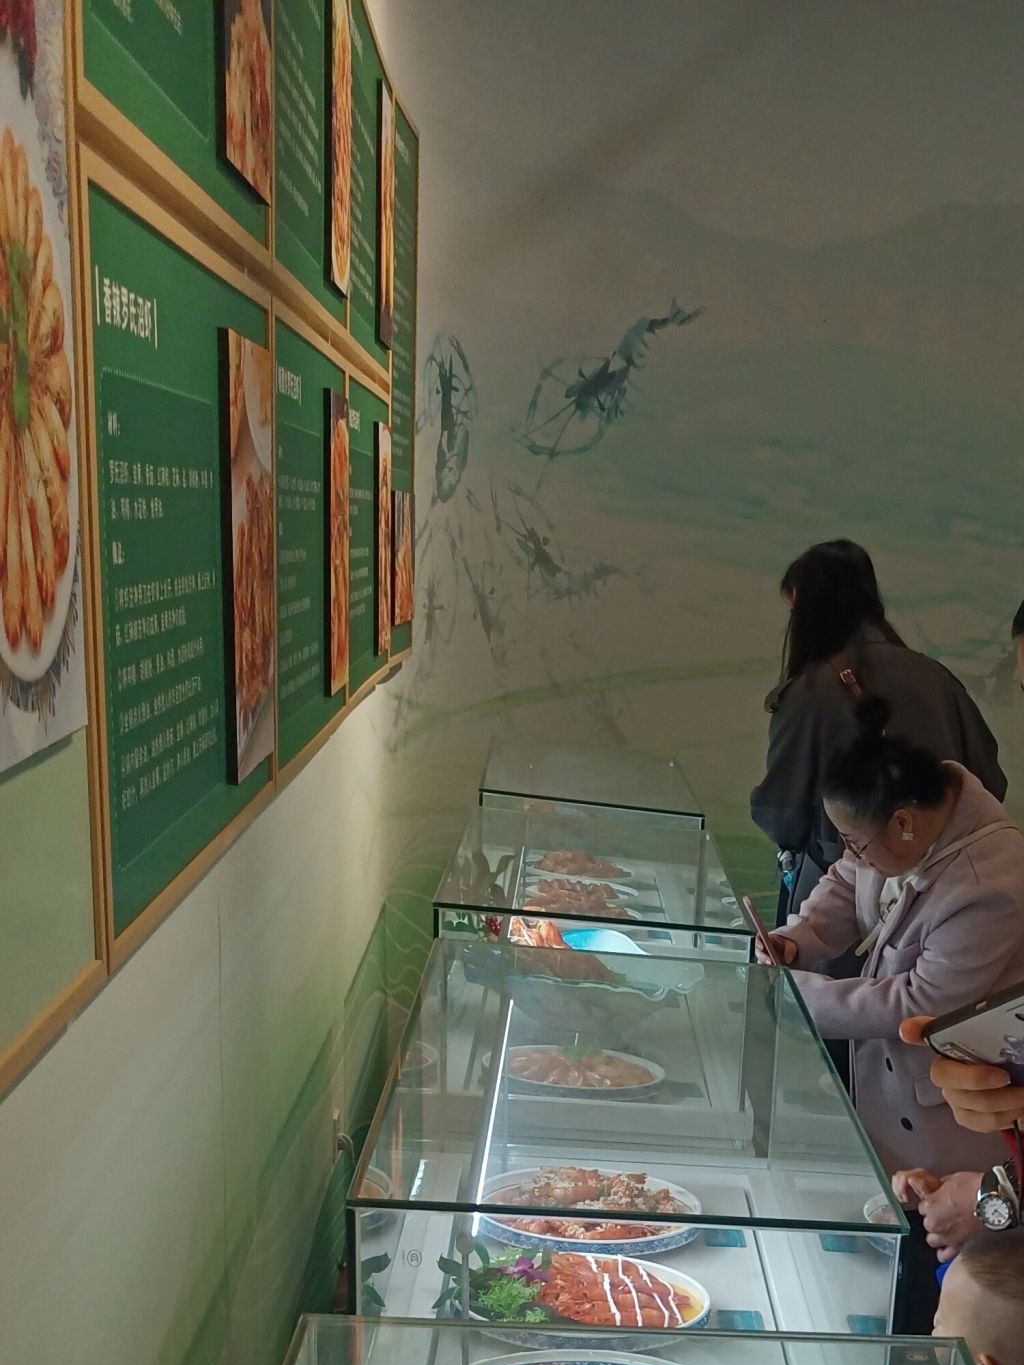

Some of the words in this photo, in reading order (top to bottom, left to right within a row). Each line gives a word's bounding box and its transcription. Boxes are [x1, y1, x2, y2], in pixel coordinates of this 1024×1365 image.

[103, 276, 152, 342] 香辣罗氏沼虾
